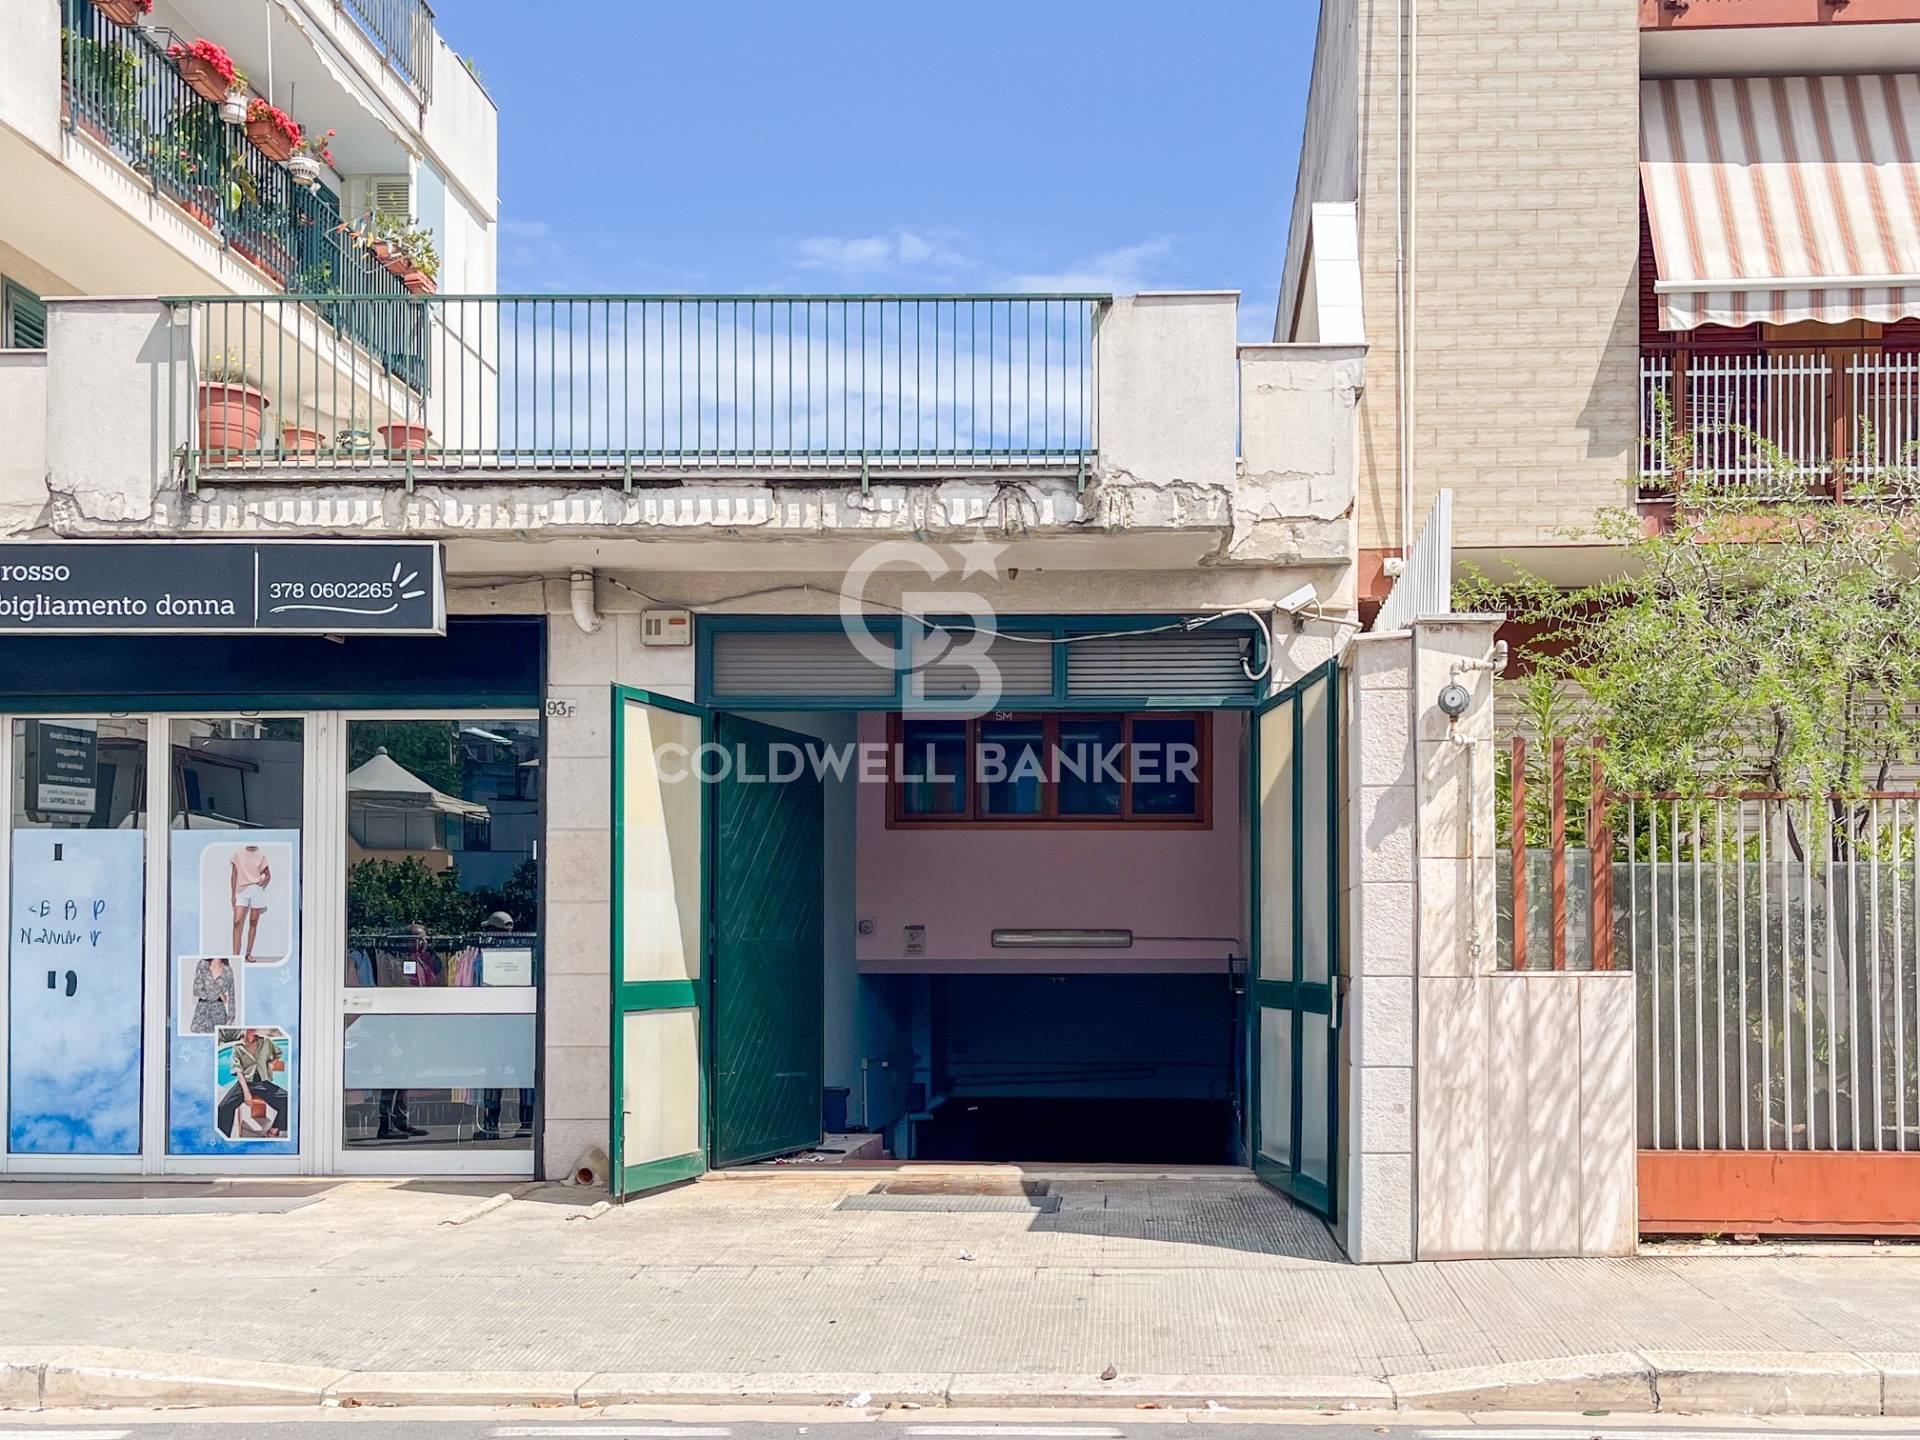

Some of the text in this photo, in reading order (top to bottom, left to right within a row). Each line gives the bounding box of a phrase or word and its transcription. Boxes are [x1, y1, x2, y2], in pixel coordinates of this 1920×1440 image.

[269, 582, 393, 599] 378 0602265
[0, 593, 236, 622] bigliamento donna
